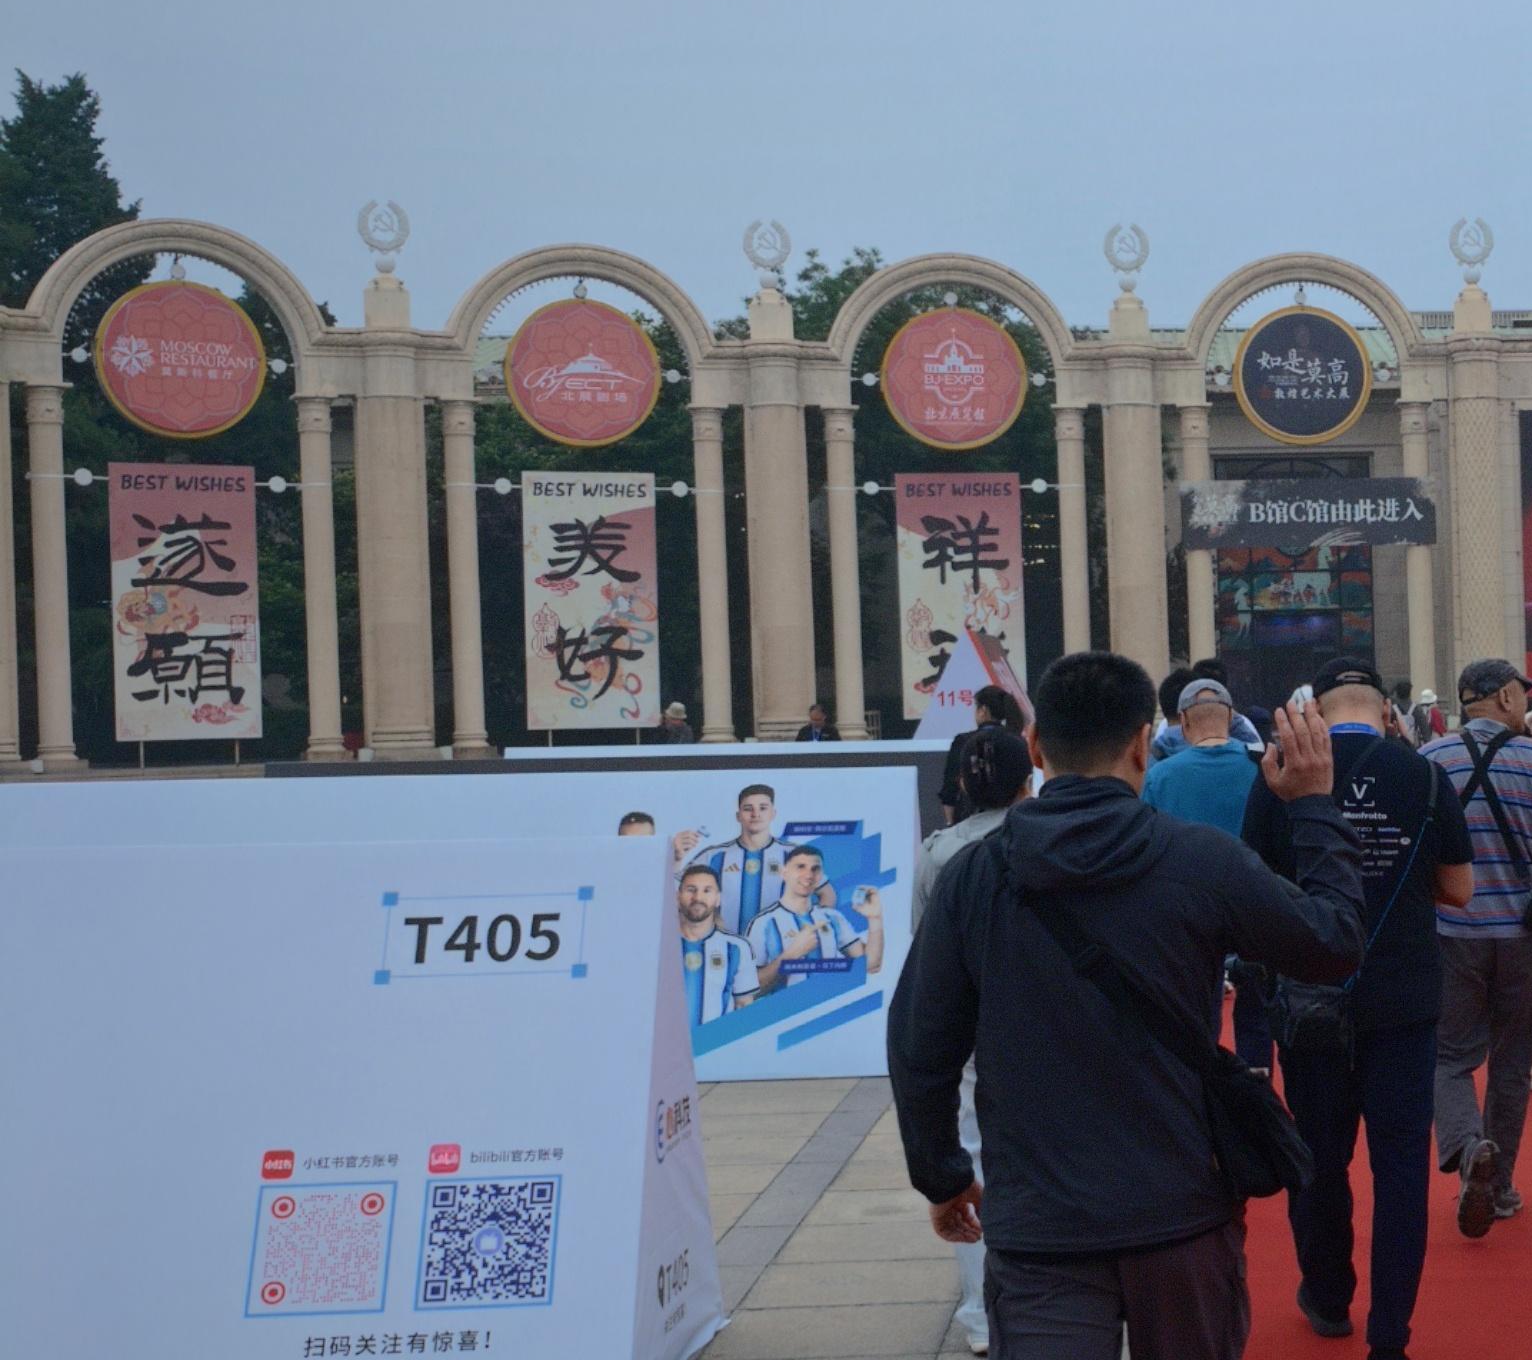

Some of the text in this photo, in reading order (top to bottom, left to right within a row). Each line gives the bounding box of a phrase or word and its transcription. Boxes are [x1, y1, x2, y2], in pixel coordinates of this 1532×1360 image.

[160, 341, 232, 354] MOSCOW
[160, 352, 256, 370] RESTAURANT
[1257, 348, 1349, 385] 如是莫高
[121, 474, 246, 491] BEST WISHES
[533, 482, 647, 498] BEST WISHES
[906, 482, 1012, 498] BEST WISHES
[1249, 498, 1425, 525] B馆C馆由此进入
[404, 912, 561, 964] T405
[303, 1153, 399, 1171] 小红书官方账号
[469, 1146, 564, 1164] bilibili官方账号
